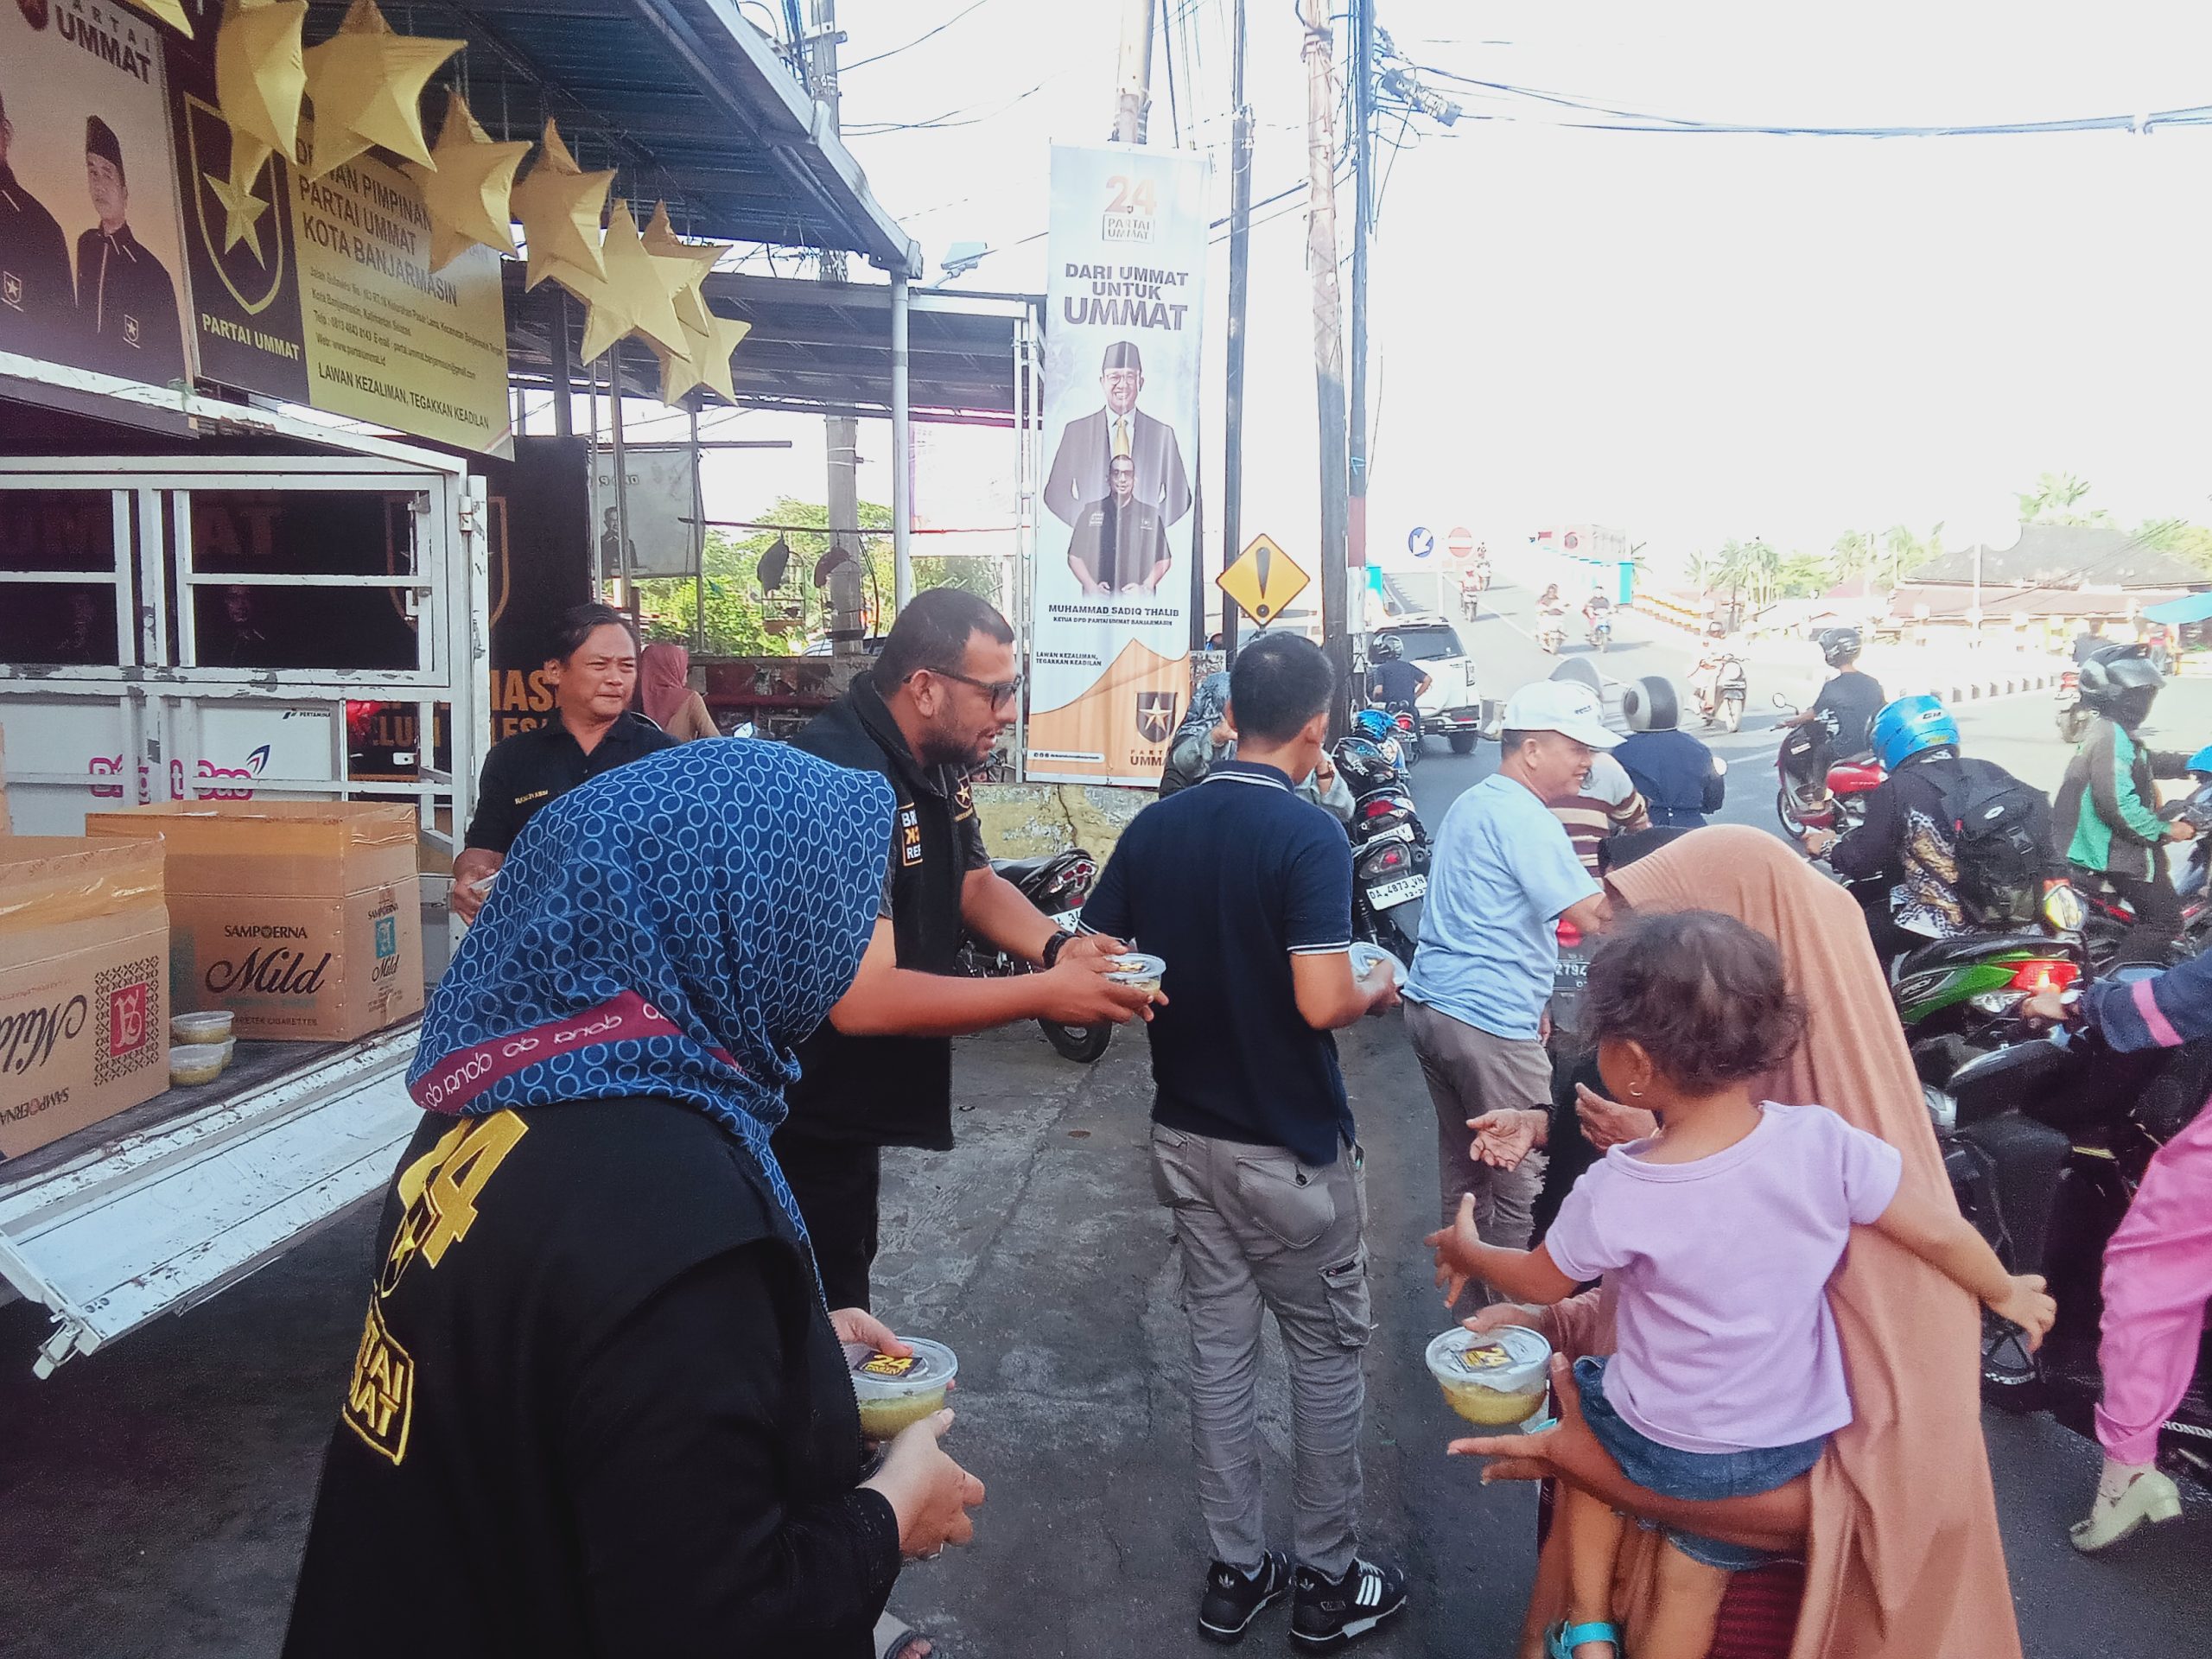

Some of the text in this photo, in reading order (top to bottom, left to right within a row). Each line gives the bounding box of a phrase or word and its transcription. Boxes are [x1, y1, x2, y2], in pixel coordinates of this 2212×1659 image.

[55, 3, 151, 85] UMMAT
[1104, 175, 1157, 216] 24
[299, 174, 416, 256] PARTAI UMMAT
[1108, 218, 1150, 230] PARTAI
[1108, 228, 1148, 240] UMMAT
[302, 212, 458, 307] KOTA BANJARMASIN
[1065, 263, 1189, 286] DARI UMMAT
[1092, 282, 1161, 301] UNTUK
[1065, 296, 1188, 330] UMMAT
[201, 313, 300, 361] PARTAI UMMAT
[318, 361, 490, 430] LAWAN KEZALIMAN, TEGAKKAN KEADILAN
[1048, 604, 1179, 617] MUHAMMAD SADIQ THALIB
[1388, 880, 1409, 893] 4873
[224, 925, 308, 939] SAMPOERNA
[206, 946, 332, 995] Mild
[372, 954, 400, 982] Mild
[870, 1354, 913, 1370] 24
